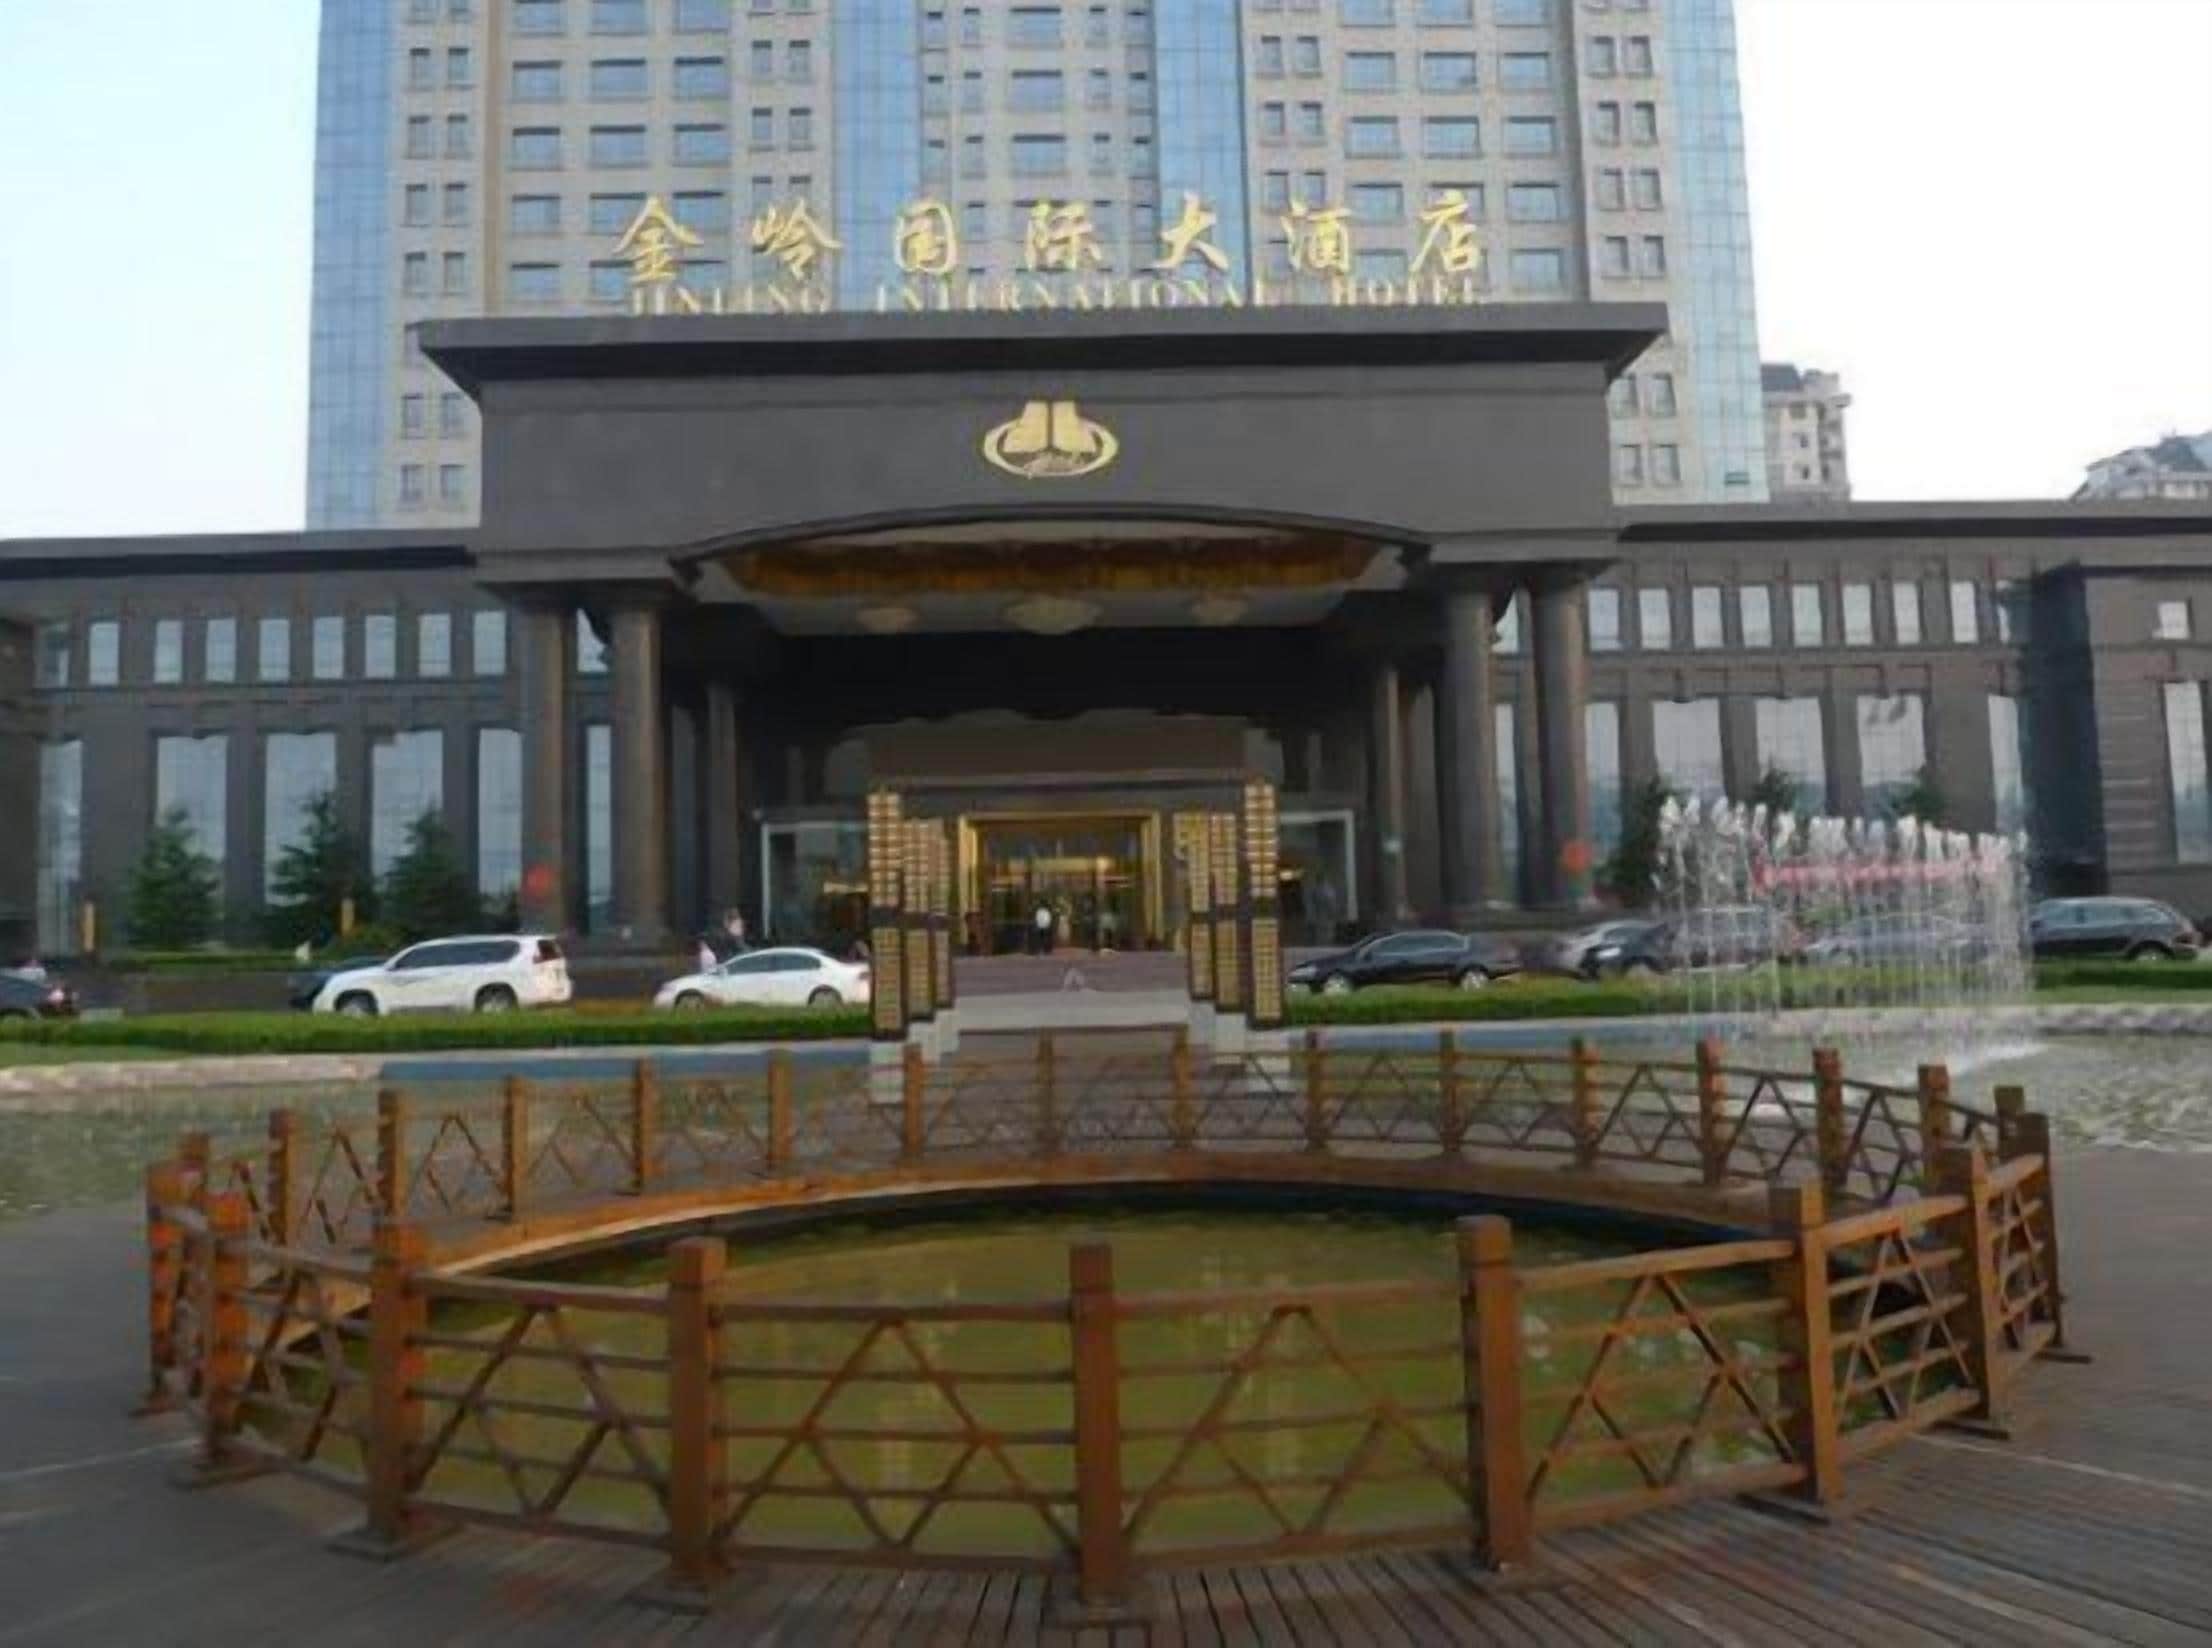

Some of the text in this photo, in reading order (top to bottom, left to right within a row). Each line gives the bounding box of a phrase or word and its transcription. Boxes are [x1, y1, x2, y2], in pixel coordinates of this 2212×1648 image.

[612, 190, 1481, 283] 金岭国际大酒店
